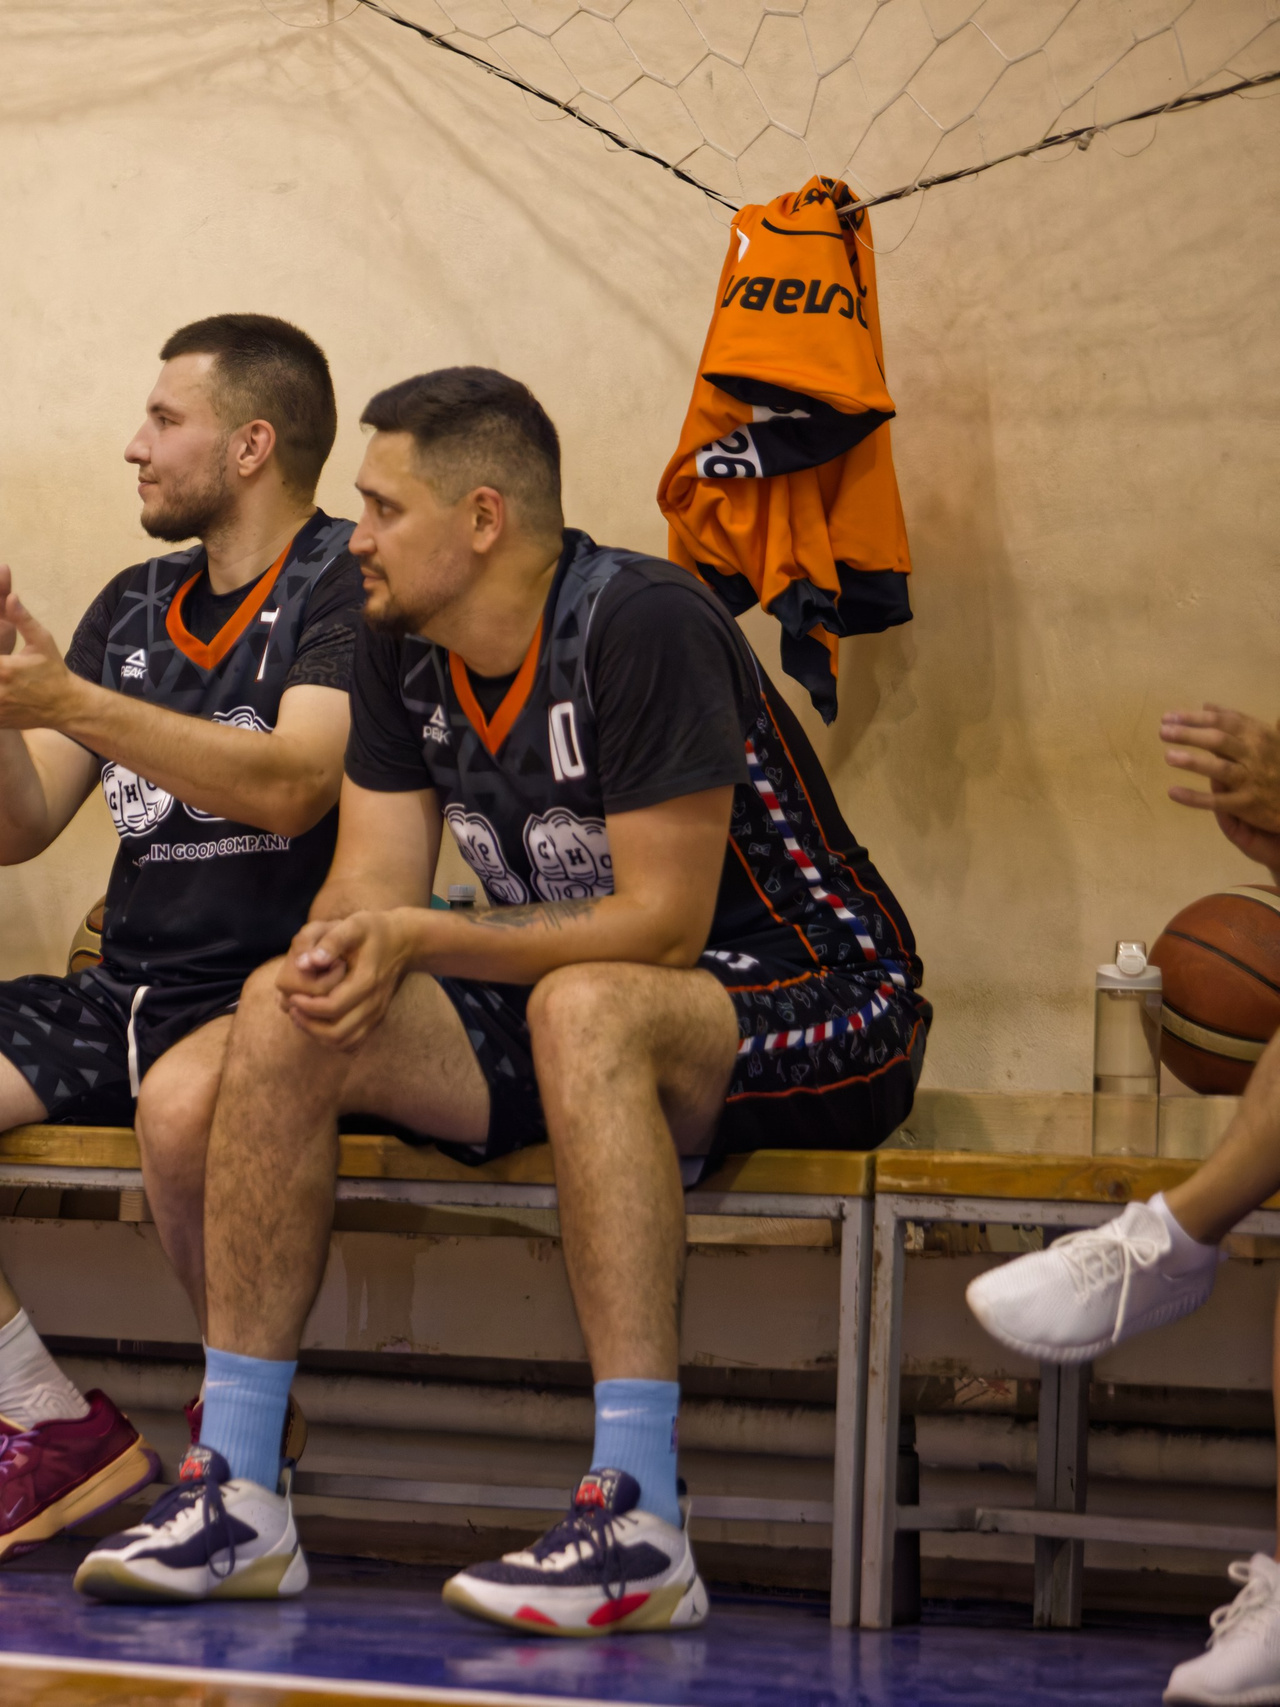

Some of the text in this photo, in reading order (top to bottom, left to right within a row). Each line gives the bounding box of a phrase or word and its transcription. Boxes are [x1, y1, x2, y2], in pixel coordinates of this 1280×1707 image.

[701, 430, 757, 478] 26
[256, 606, 281, 681] 7
[120, 665, 148, 679] PEAK
[548, 701, 586, 781] 10
[150, 833, 291, 861] IN GOOD COMPANY
